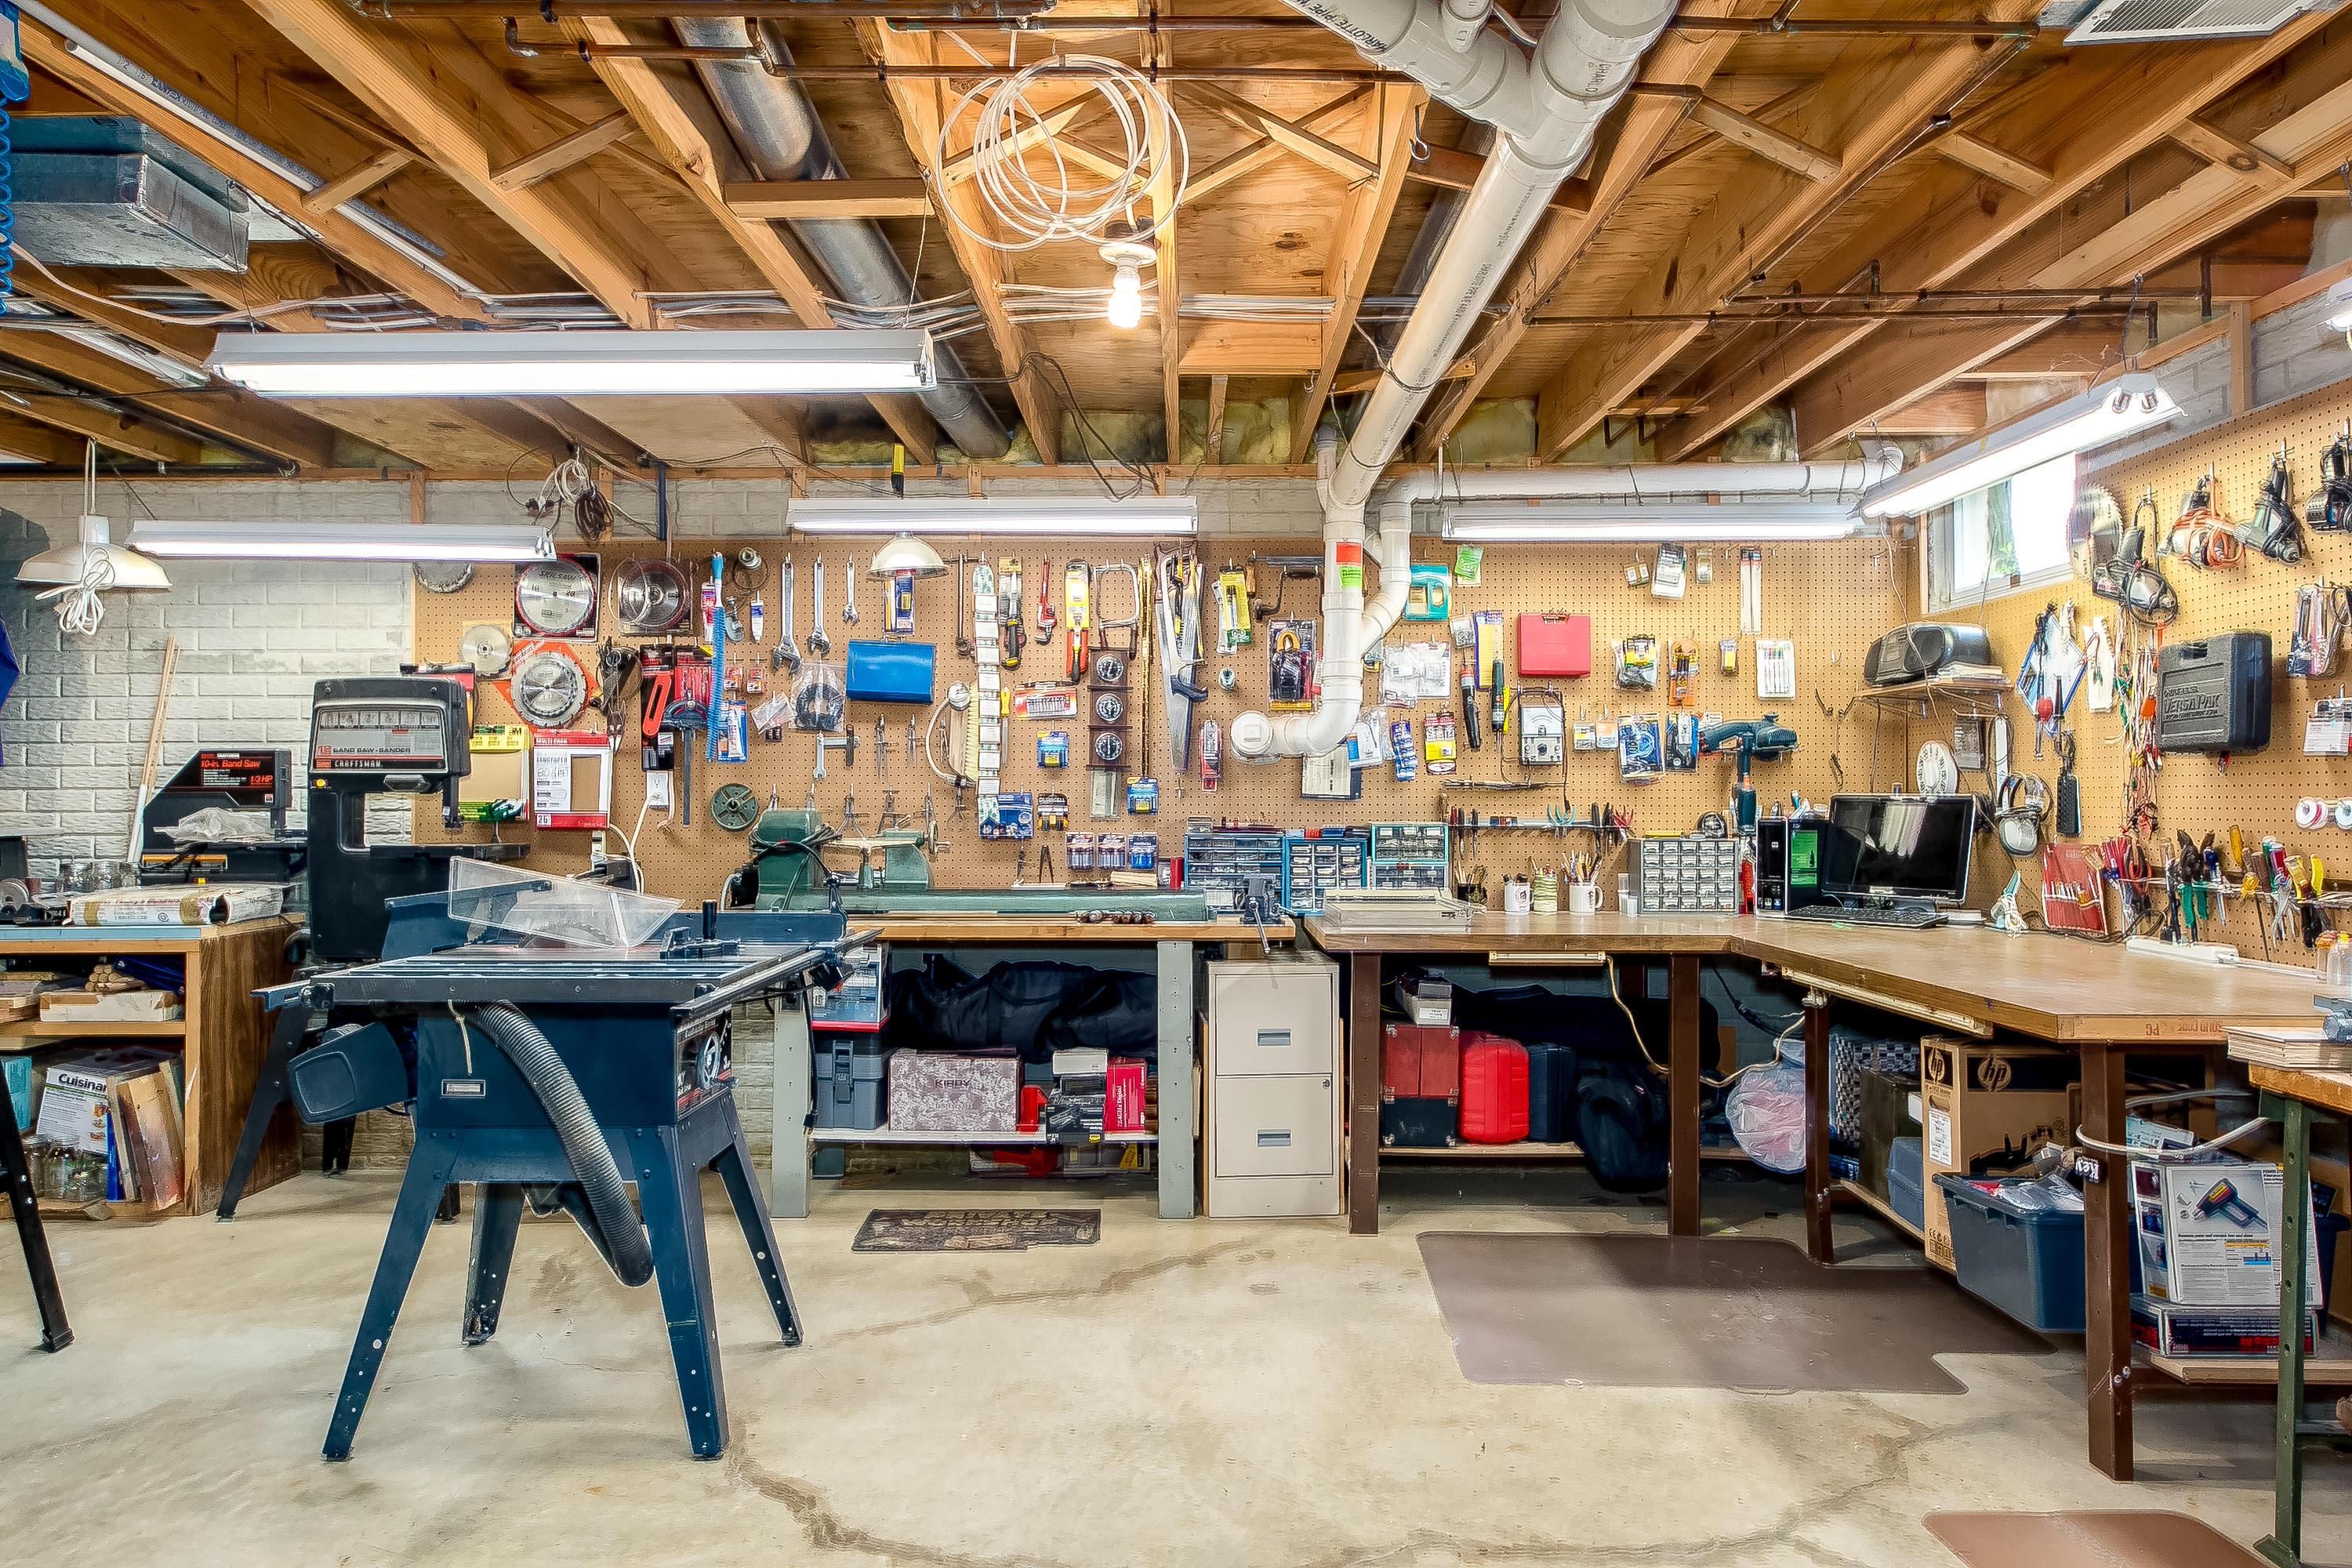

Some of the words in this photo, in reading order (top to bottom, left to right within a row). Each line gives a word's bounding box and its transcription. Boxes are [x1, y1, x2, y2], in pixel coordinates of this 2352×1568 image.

[1308, 2, 1338, 20] PIPE
[1337, 17, 1387, 52] HARLOTTE
[1584, 64, 1612, 93] CHARLO
[539, 570, 576, 581] SKILSAW
[509, 728, 522, 736] 3M
[1929, 1047, 1944, 1083] hp
[1981, 1054, 2009, 1092] hp
[58, 1073, 107, 1092] Cuisinar
[935, 1078, 972, 1089] KIRBY
[2075, 1156, 2100, 1180] Key
